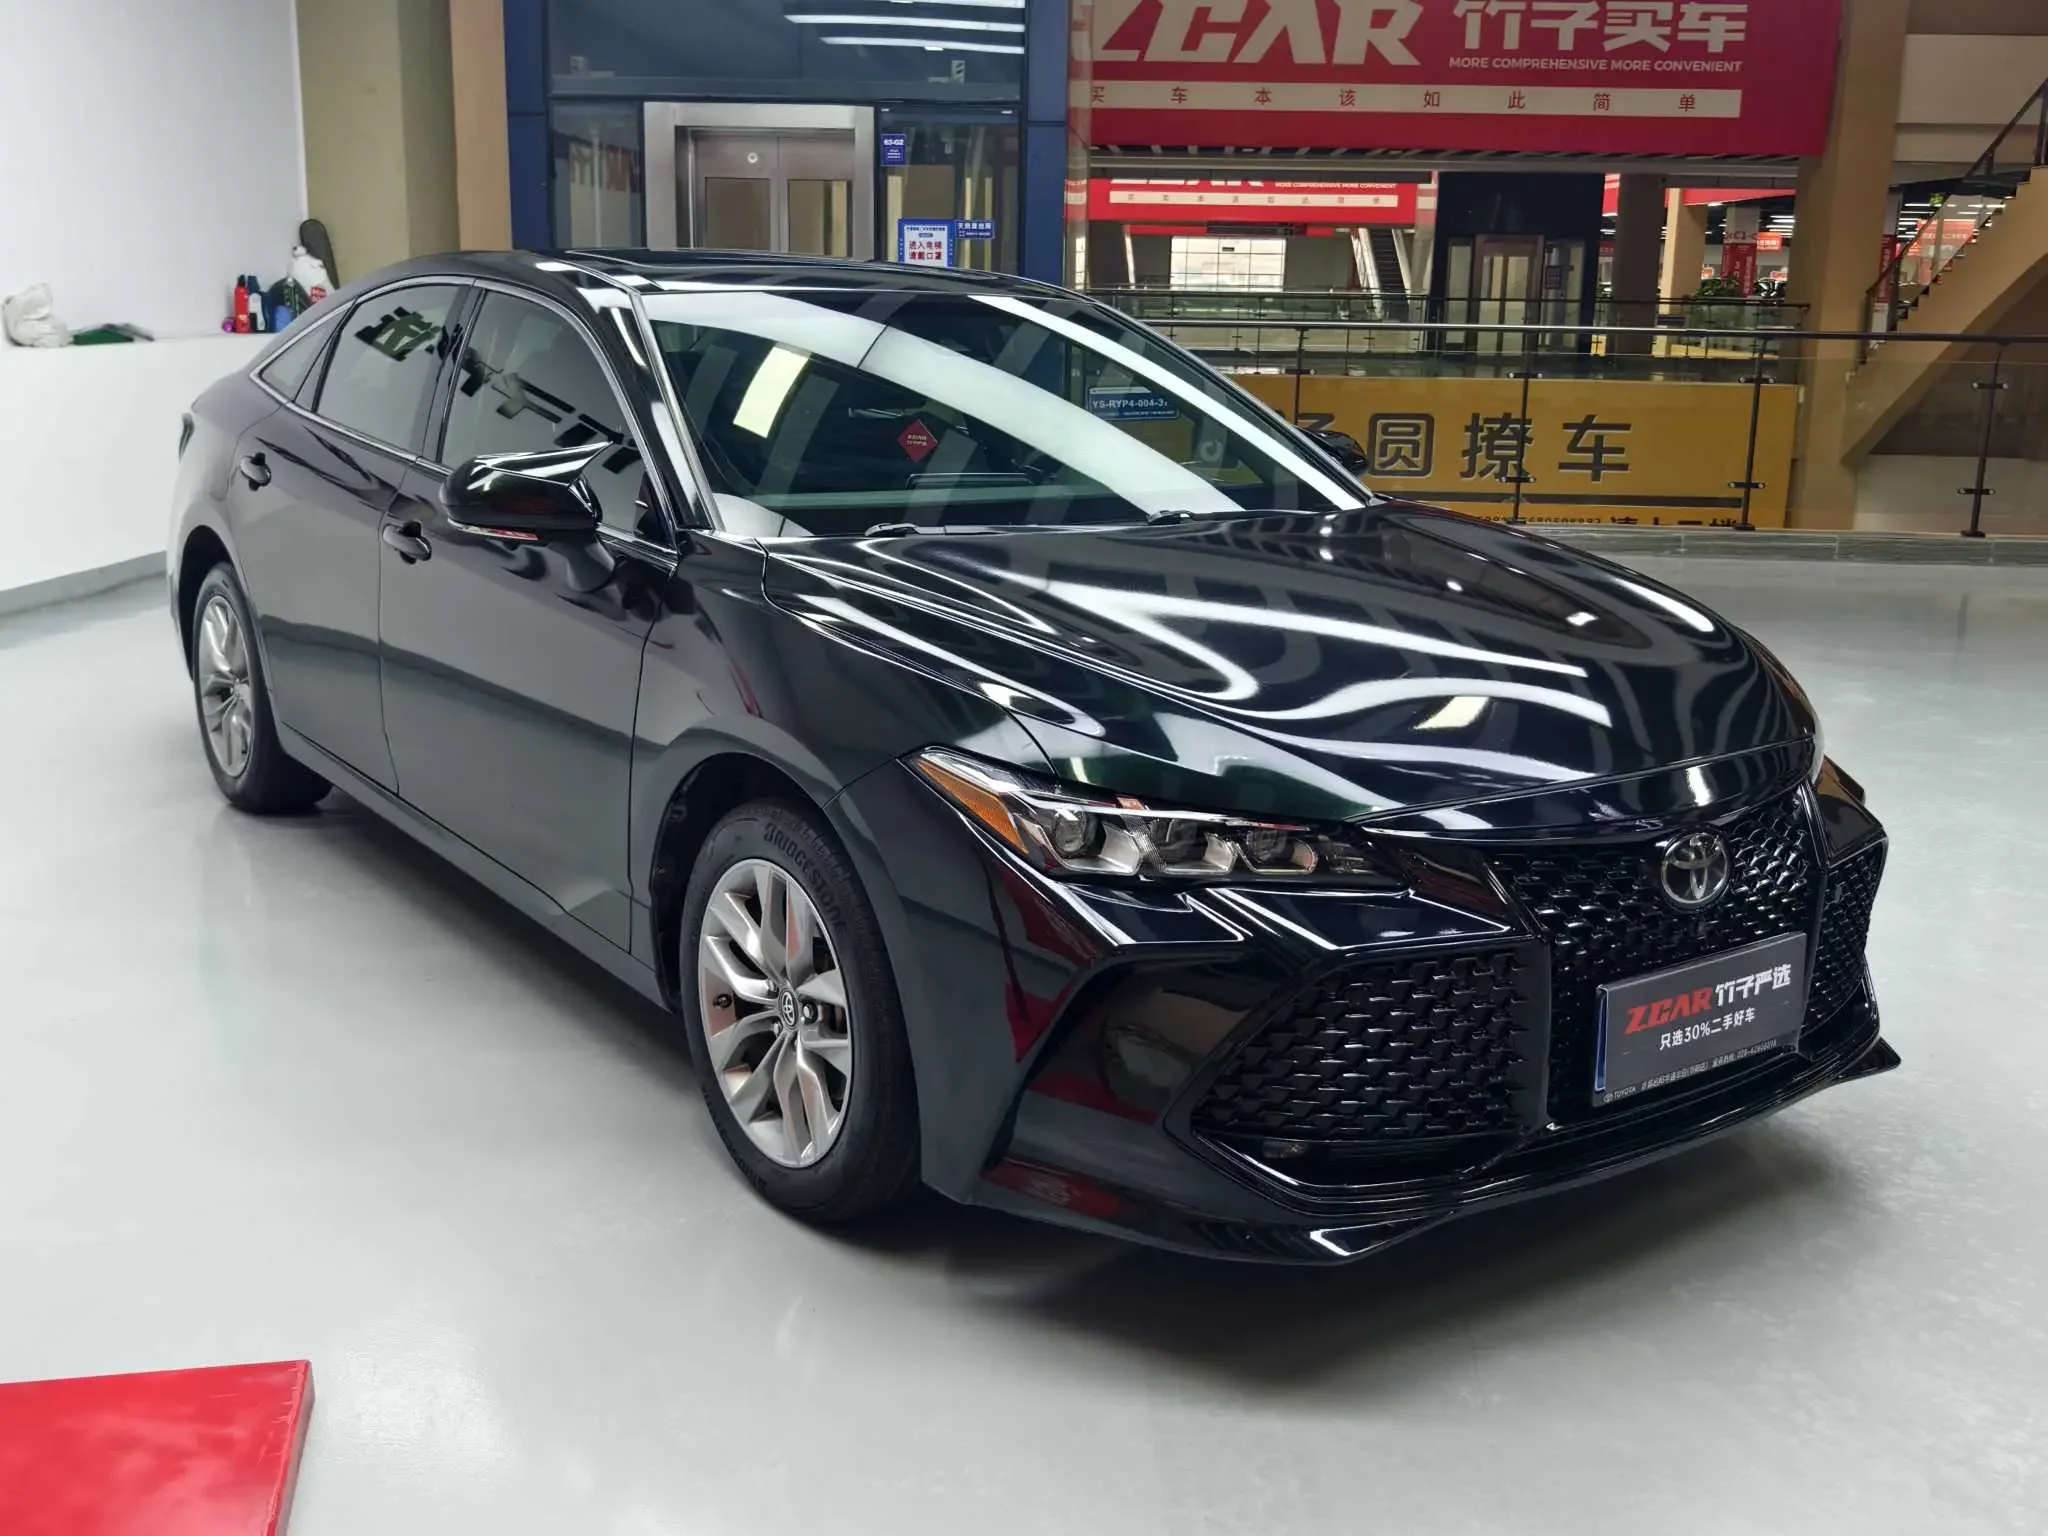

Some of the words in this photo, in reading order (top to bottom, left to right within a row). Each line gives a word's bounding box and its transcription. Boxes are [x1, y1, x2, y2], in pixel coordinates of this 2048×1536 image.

[1071, 0, 1424, 65] ZCAR
[1451, 0, 1749, 53] 竹子买车
[1449, 57, 1489, 69] MORE
[1492, 58, 1608, 71] COMPREHENSIVE
[1610, 60, 1651, 72] MORE
[1653, 60, 1744, 73] CONVENIENT
[1624, 986, 1714, 1035] ZCAR
[1715, 963, 1792, 1007] 竹子严选
[1659, 1007, 1756, 1051] 只选30%二手好车
